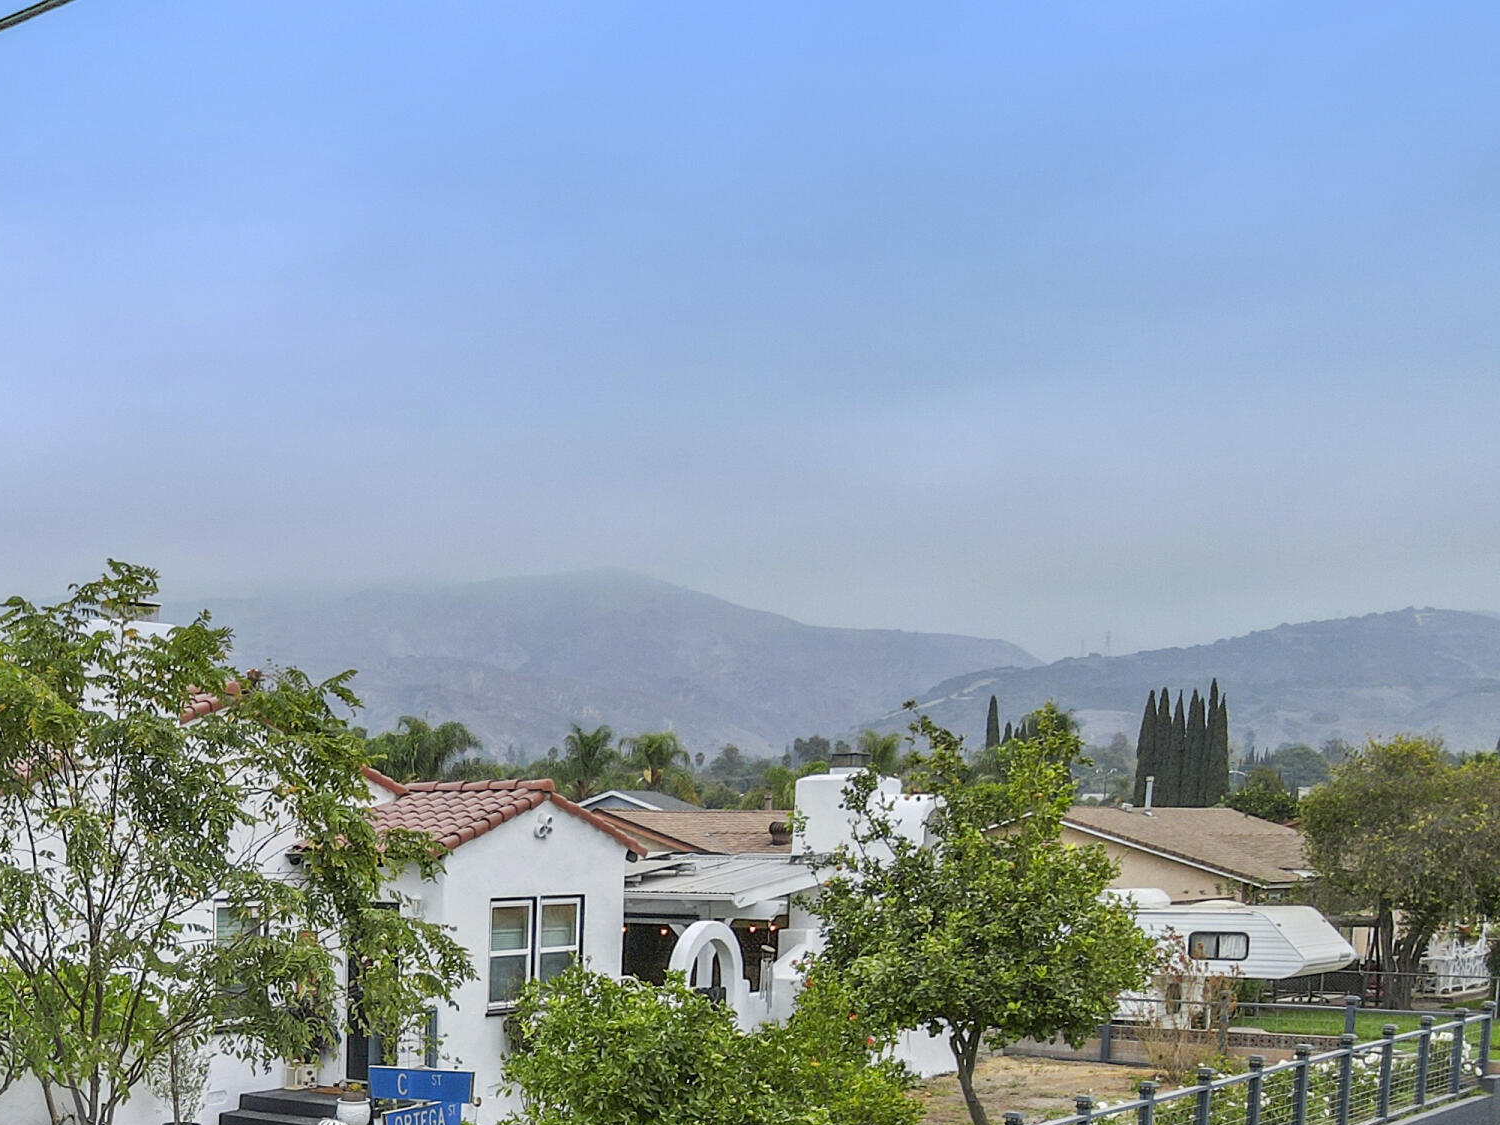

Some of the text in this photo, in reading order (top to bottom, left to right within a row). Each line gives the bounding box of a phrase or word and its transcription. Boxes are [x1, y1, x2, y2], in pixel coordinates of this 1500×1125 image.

[397, 1073, 442, 1096] C ST
[447, 1104, 456, 1116] ST
